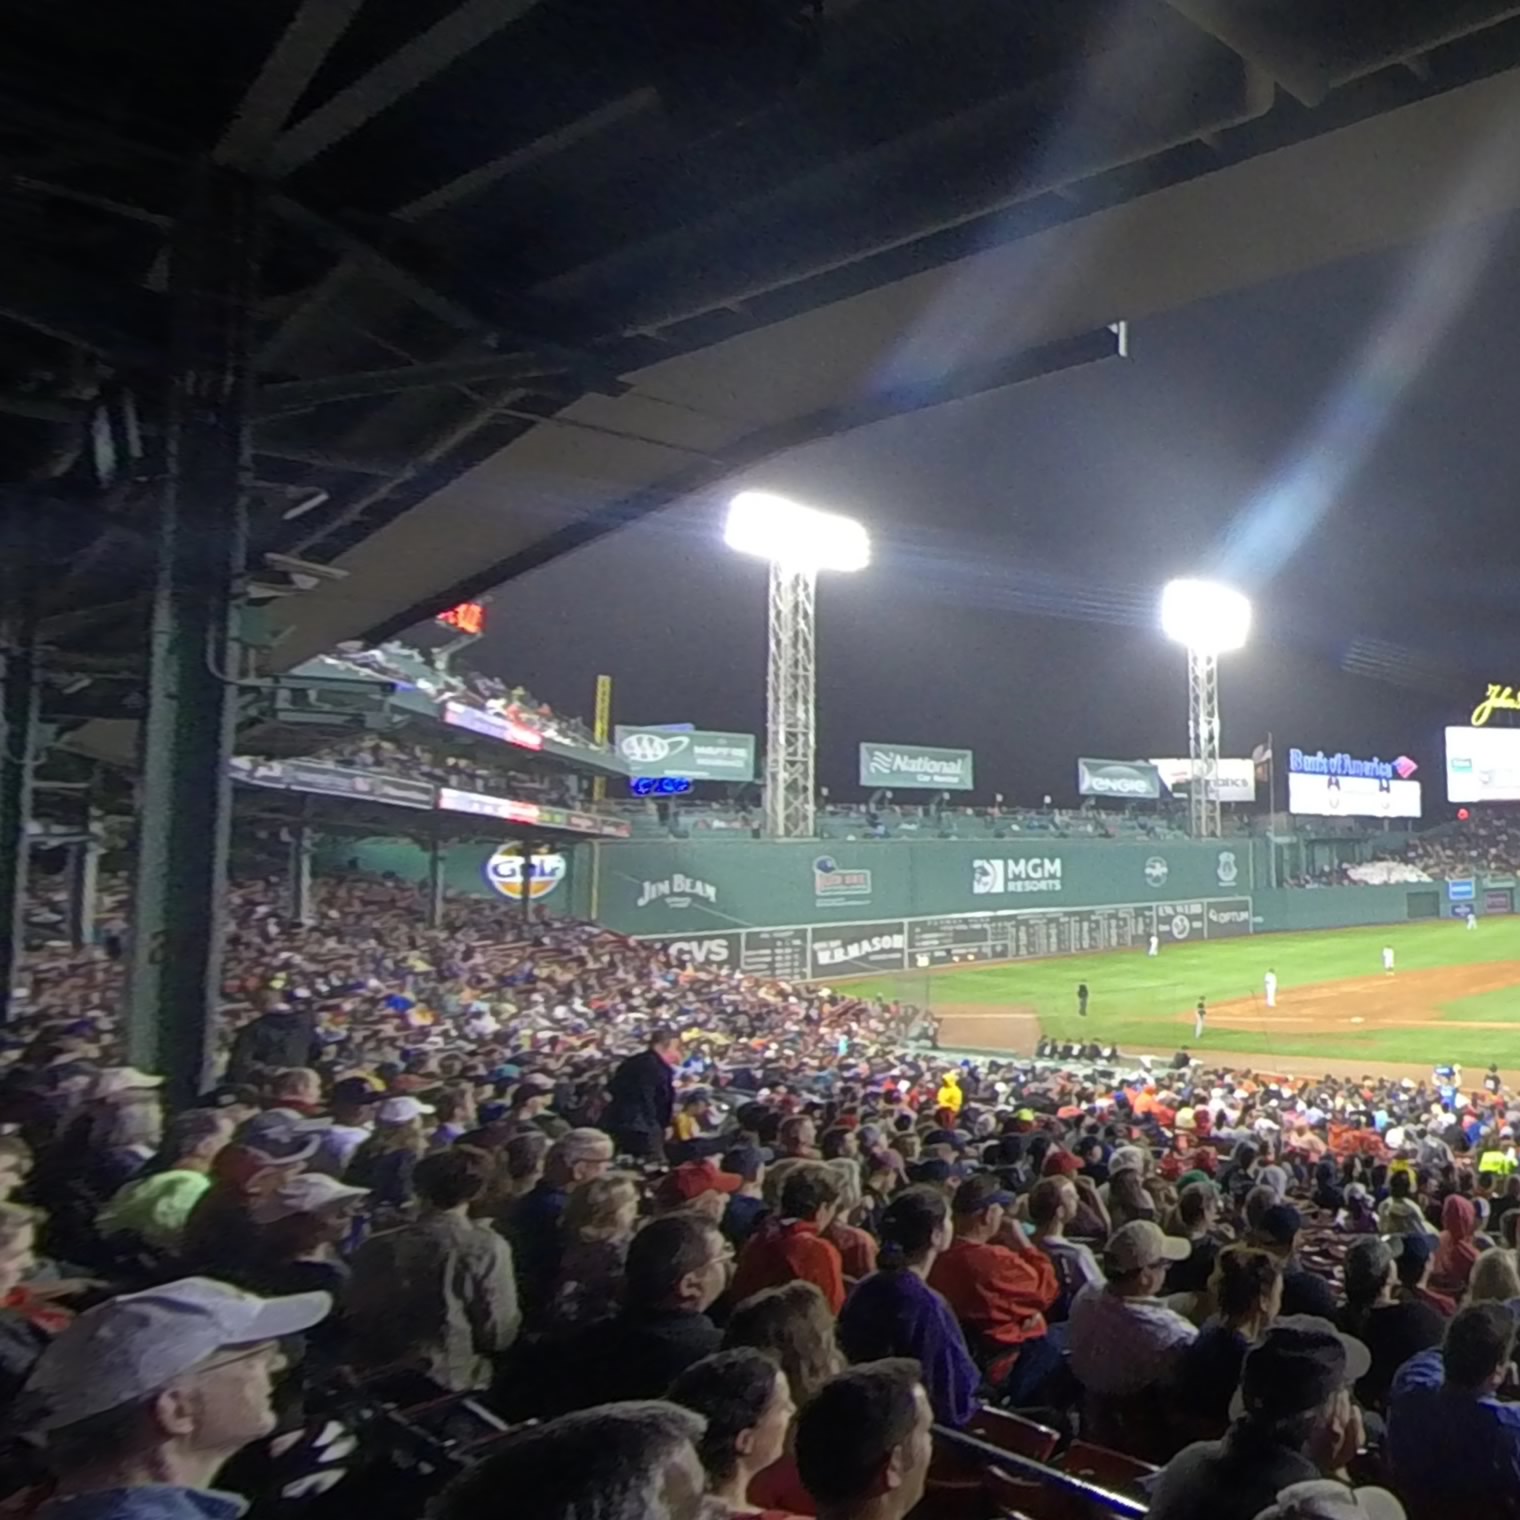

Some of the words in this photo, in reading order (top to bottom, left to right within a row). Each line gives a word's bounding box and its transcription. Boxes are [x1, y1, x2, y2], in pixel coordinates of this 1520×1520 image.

[892, 754, 963, 774] National
[1289, 748, 1328, 773] Bank
[1342, 754, 1393, 778] America
[1007, 858, 1062, 879] MGM
[637, 880, 670, 907] JIM
[673, 874, 717, 903] BEAM
[1007, 880, 1062, 892] RESORTS
[668, 938, 729, 963] CVS
[846, 934, 905, 958] MASON
